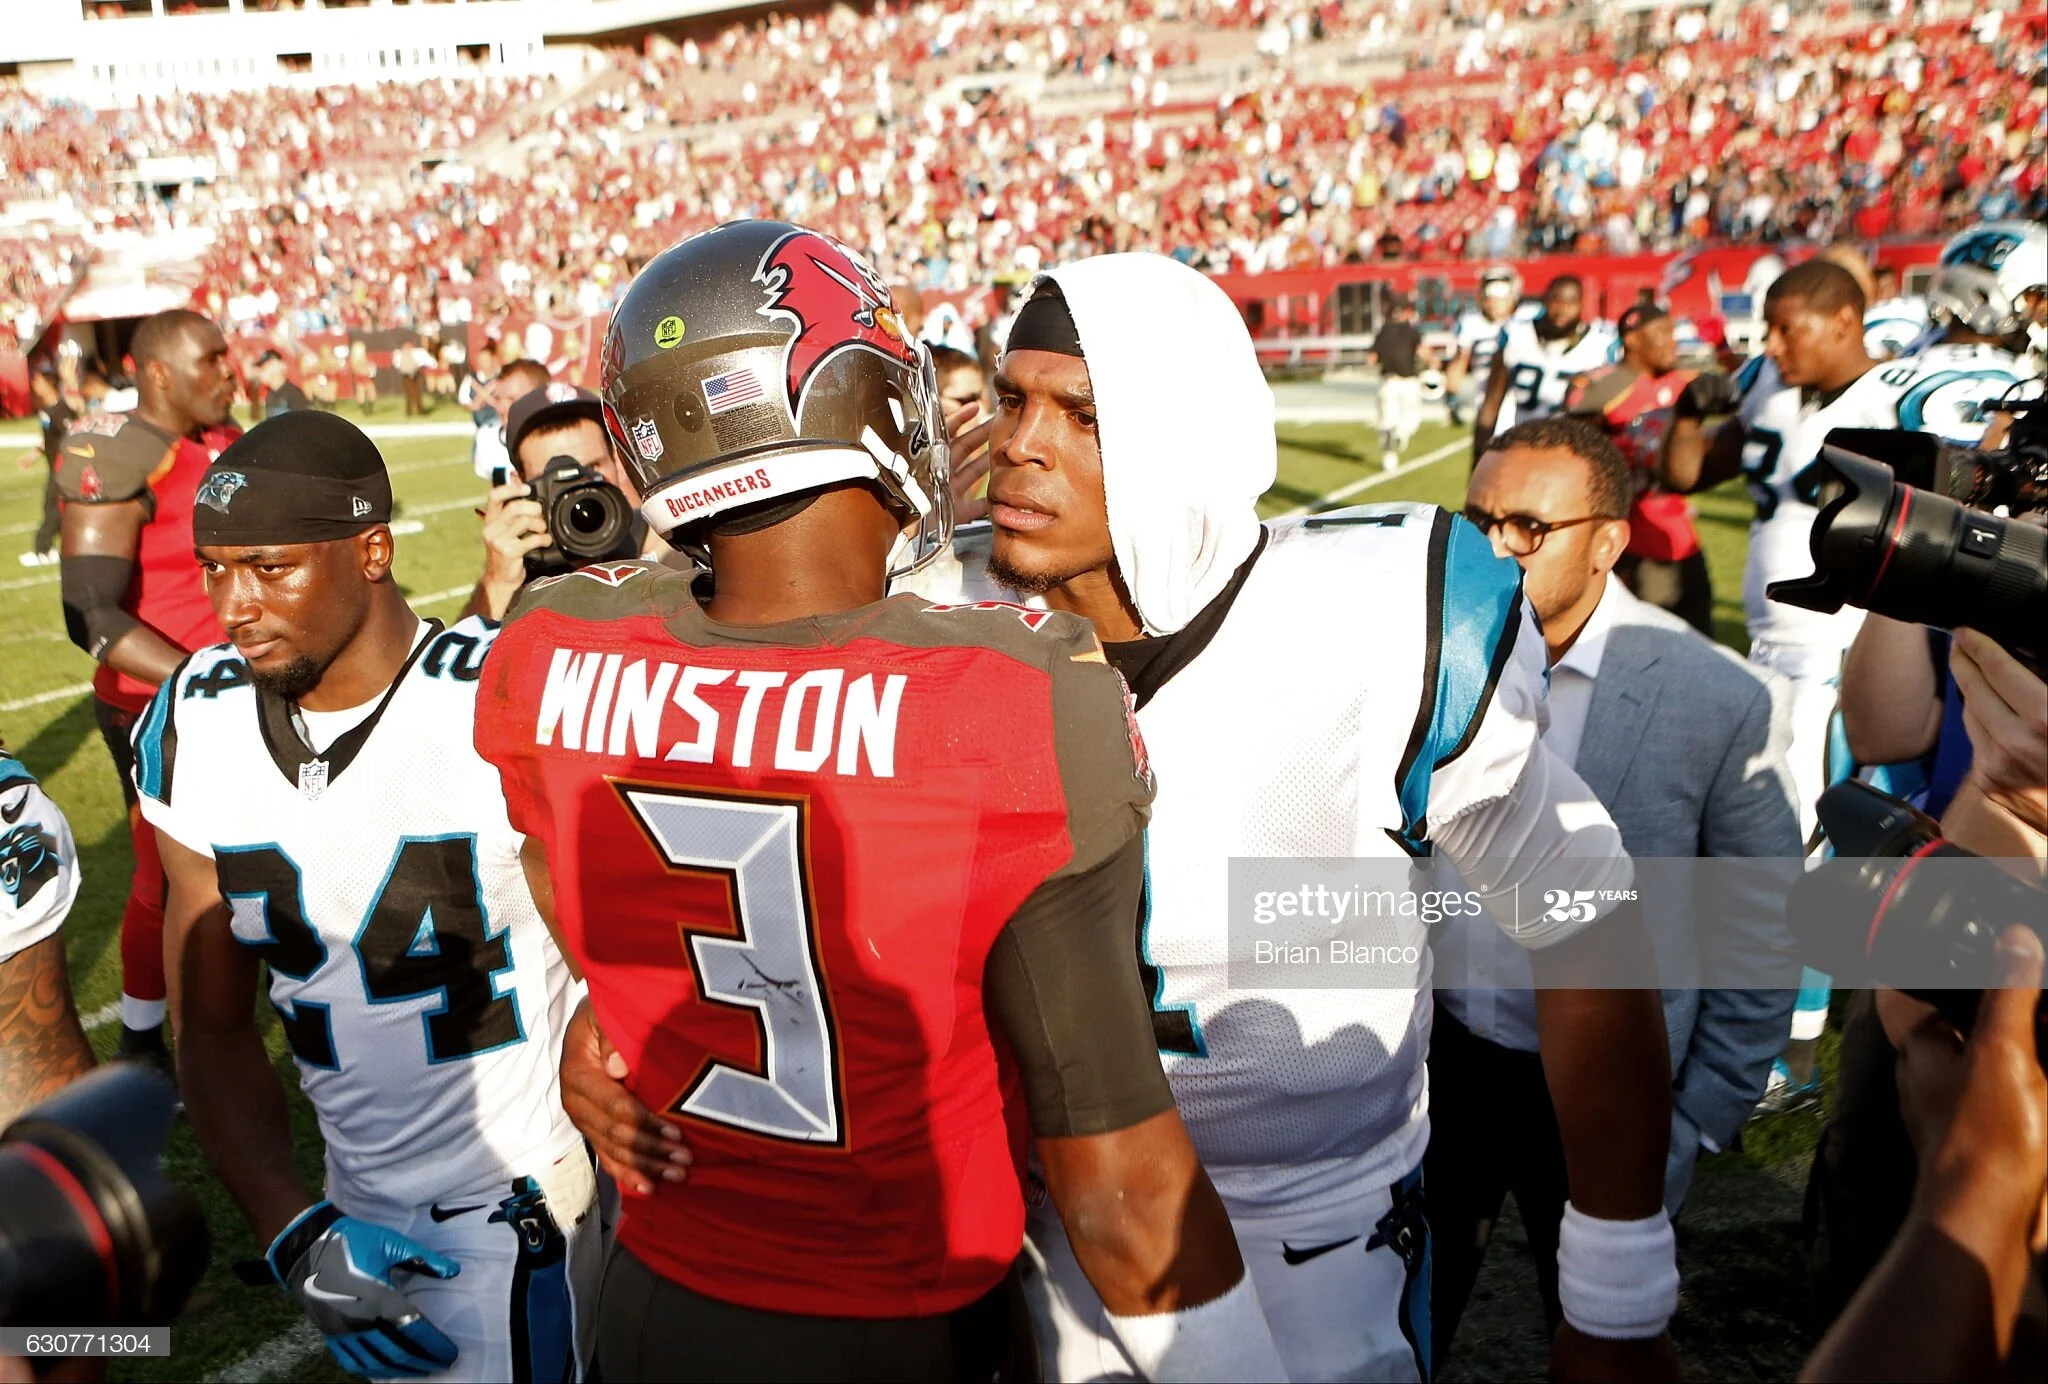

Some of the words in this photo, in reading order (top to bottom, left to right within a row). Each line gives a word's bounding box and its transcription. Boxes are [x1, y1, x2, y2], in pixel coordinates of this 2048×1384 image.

[640, 435, 660, 455] NFL
[665, 468, 771, 518] BUCCANEERS
[536, 648, 907, 778] WINSTON
[303, 777, 324, 793] NFL
[210, 832, 528, 1072] 24
[602, 774, 851, 1153] 3
